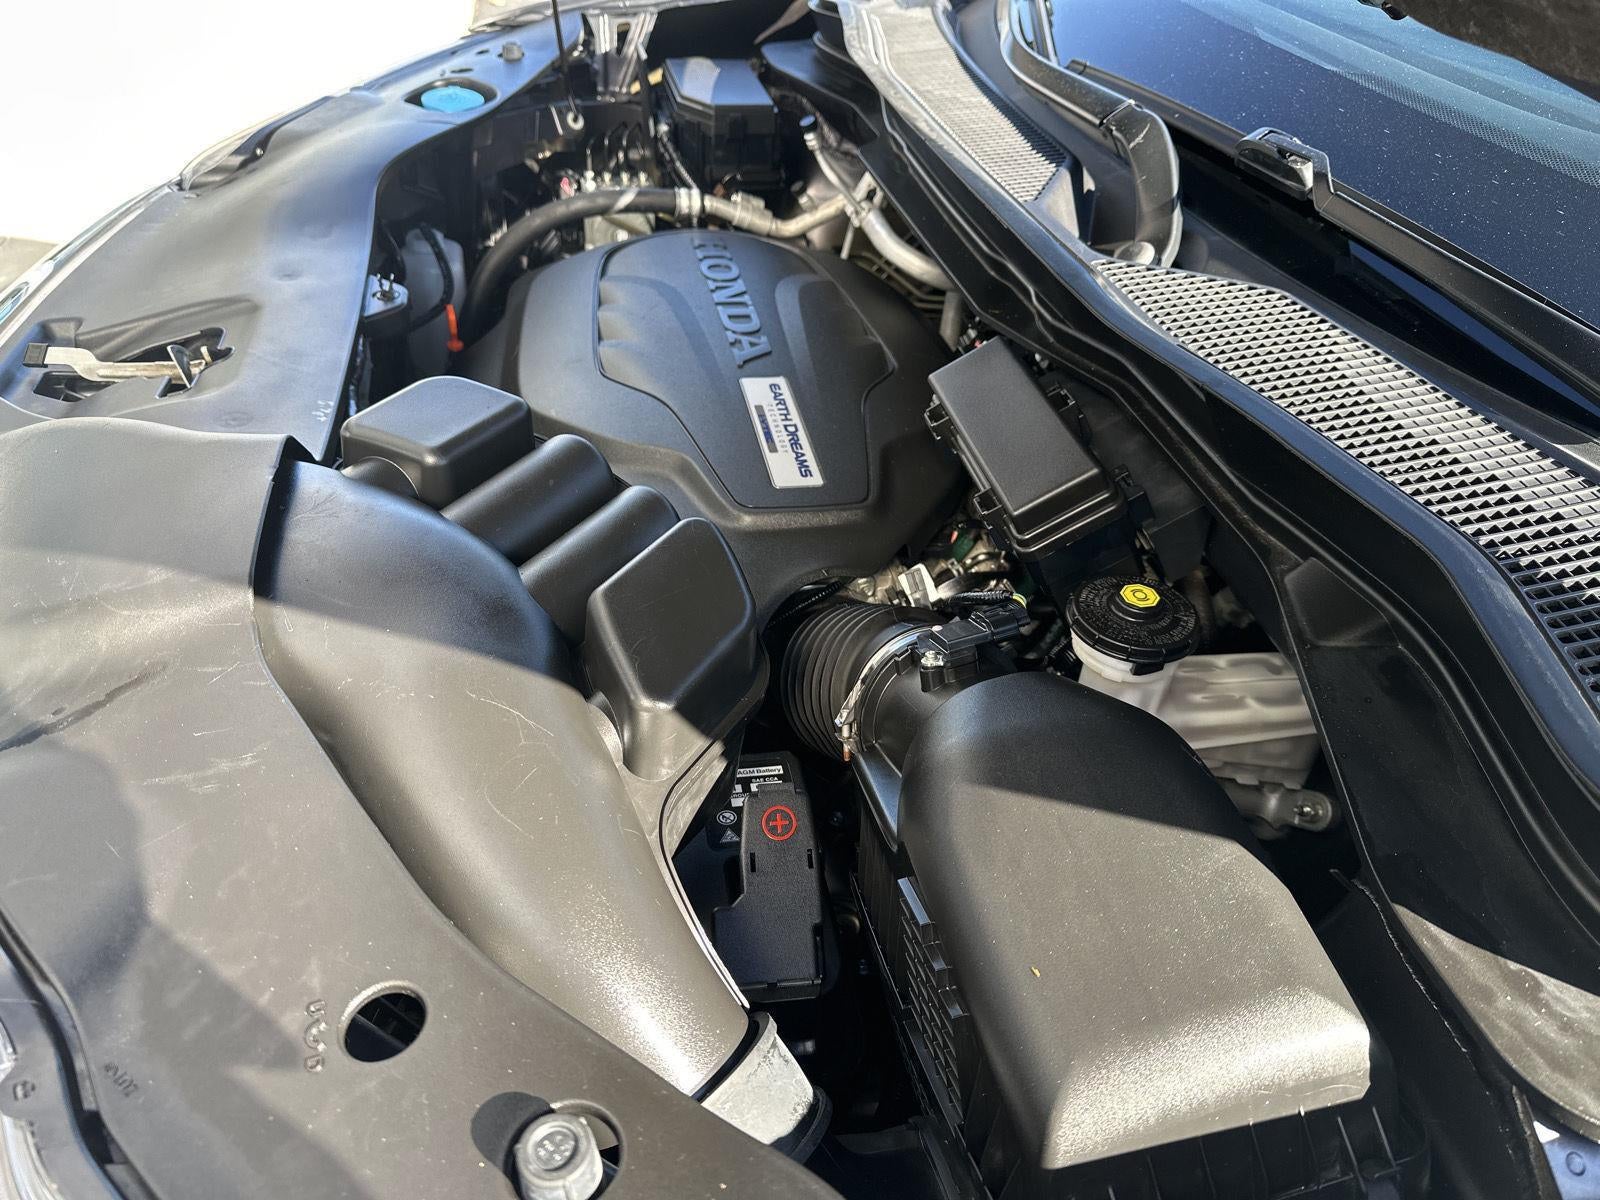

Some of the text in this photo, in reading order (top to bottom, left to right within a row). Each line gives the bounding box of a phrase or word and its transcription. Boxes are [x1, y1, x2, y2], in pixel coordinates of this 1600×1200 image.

[692, 234, 772, 368] HONDA
[769, 383, 813, 478] EARTH DREAMS
